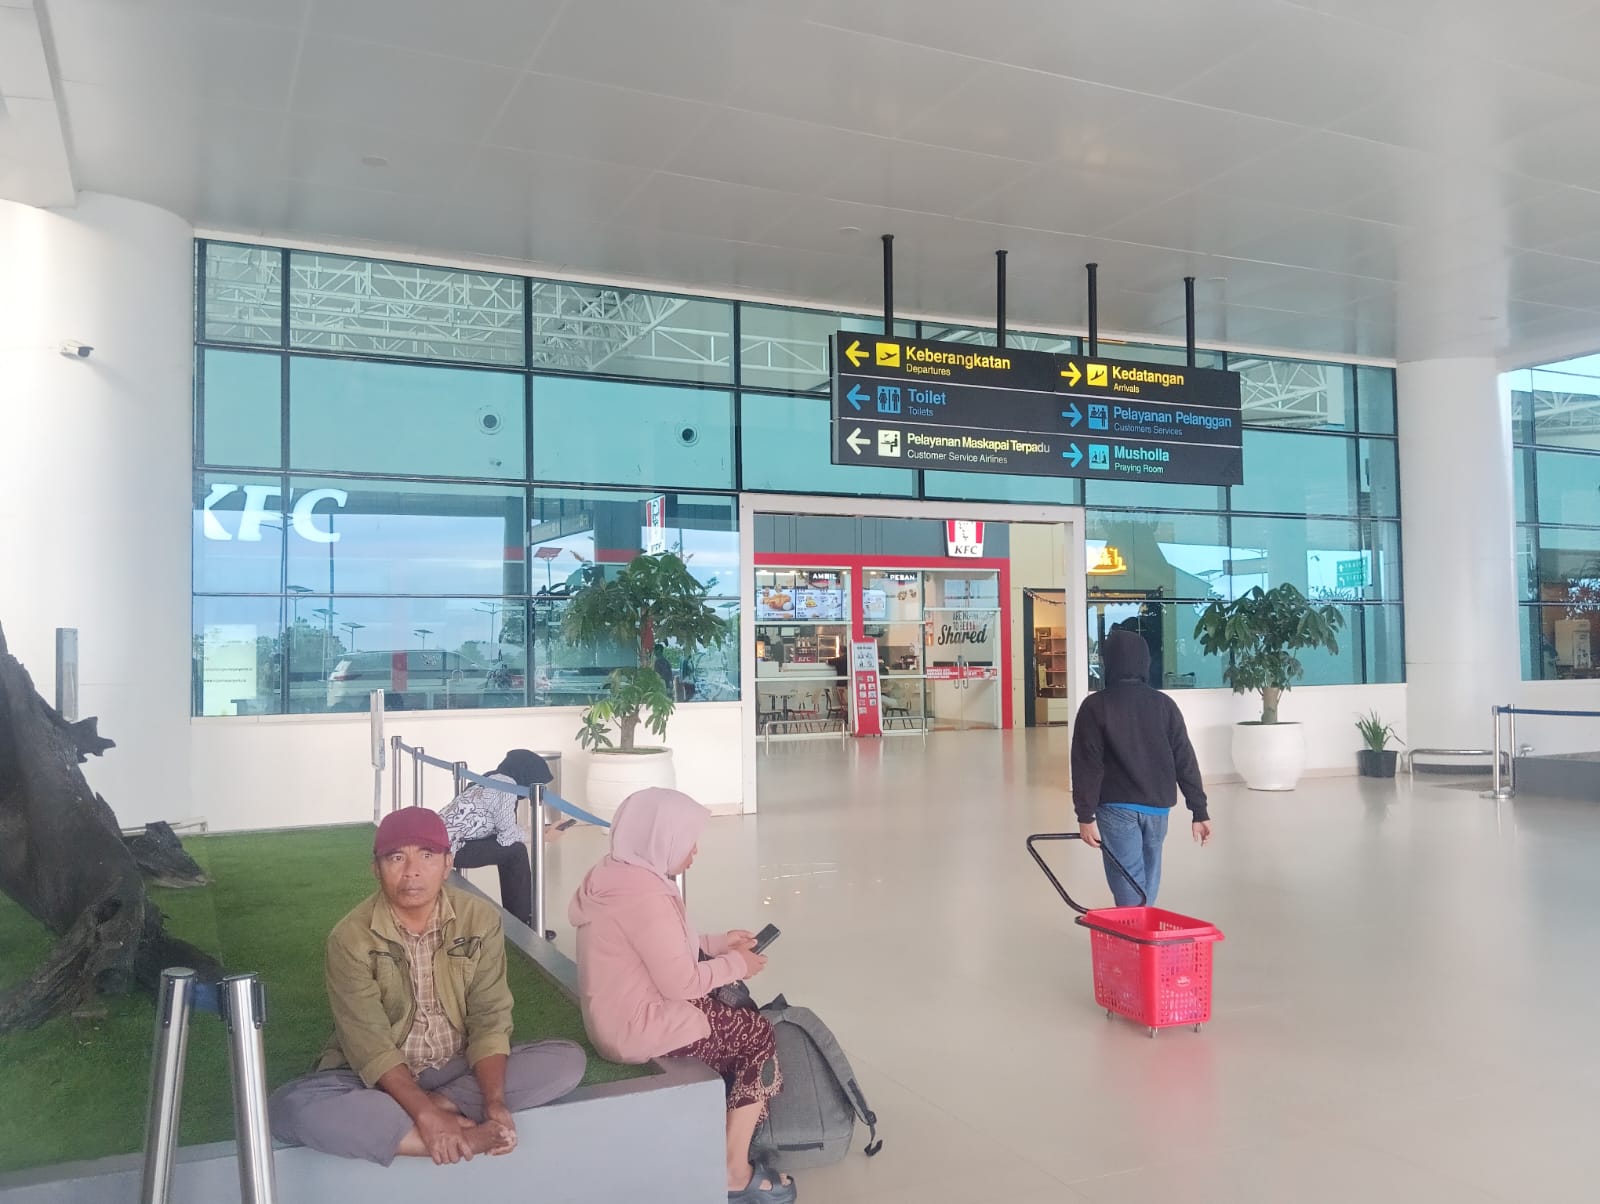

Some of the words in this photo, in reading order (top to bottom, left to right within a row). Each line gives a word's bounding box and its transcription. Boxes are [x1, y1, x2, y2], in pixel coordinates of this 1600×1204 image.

[905, 346, 1011, 370] Keberangkatan
[906, 363, 951, 377] Departures
[1112, 365, 1185, 387] Kedatangan
[1113, 382, 1140, 394] Arrivals
[907, 388, 947, 406] Toilet
[908, 406, 934, 417] Toilets
[1113, 406, 1172, 424] Pelayanan
[1175, 411, 1232, 430] Pelanggan
[1114, 422, 1152, 434] Customers
[1153, 425, 1183, 436] Services
[907, 432, 961, 449] Pelayanan
[962, 436, 1010, 453] Maskapai
[1010, 440, 1051, 455] Terpadu
[907, 449, 947, 461] Customer
[948, 451, 978, 463] Service
[979, 453, 1008, 464] Airlines
[1114, 445, 1170, 462] Musholla
[1114, 462, 1141, 474] Praying
[1143, 464, 1164, 474] Room
[954, 545, 978, 555] KFC
[937, 623, 988, 645] Shared
